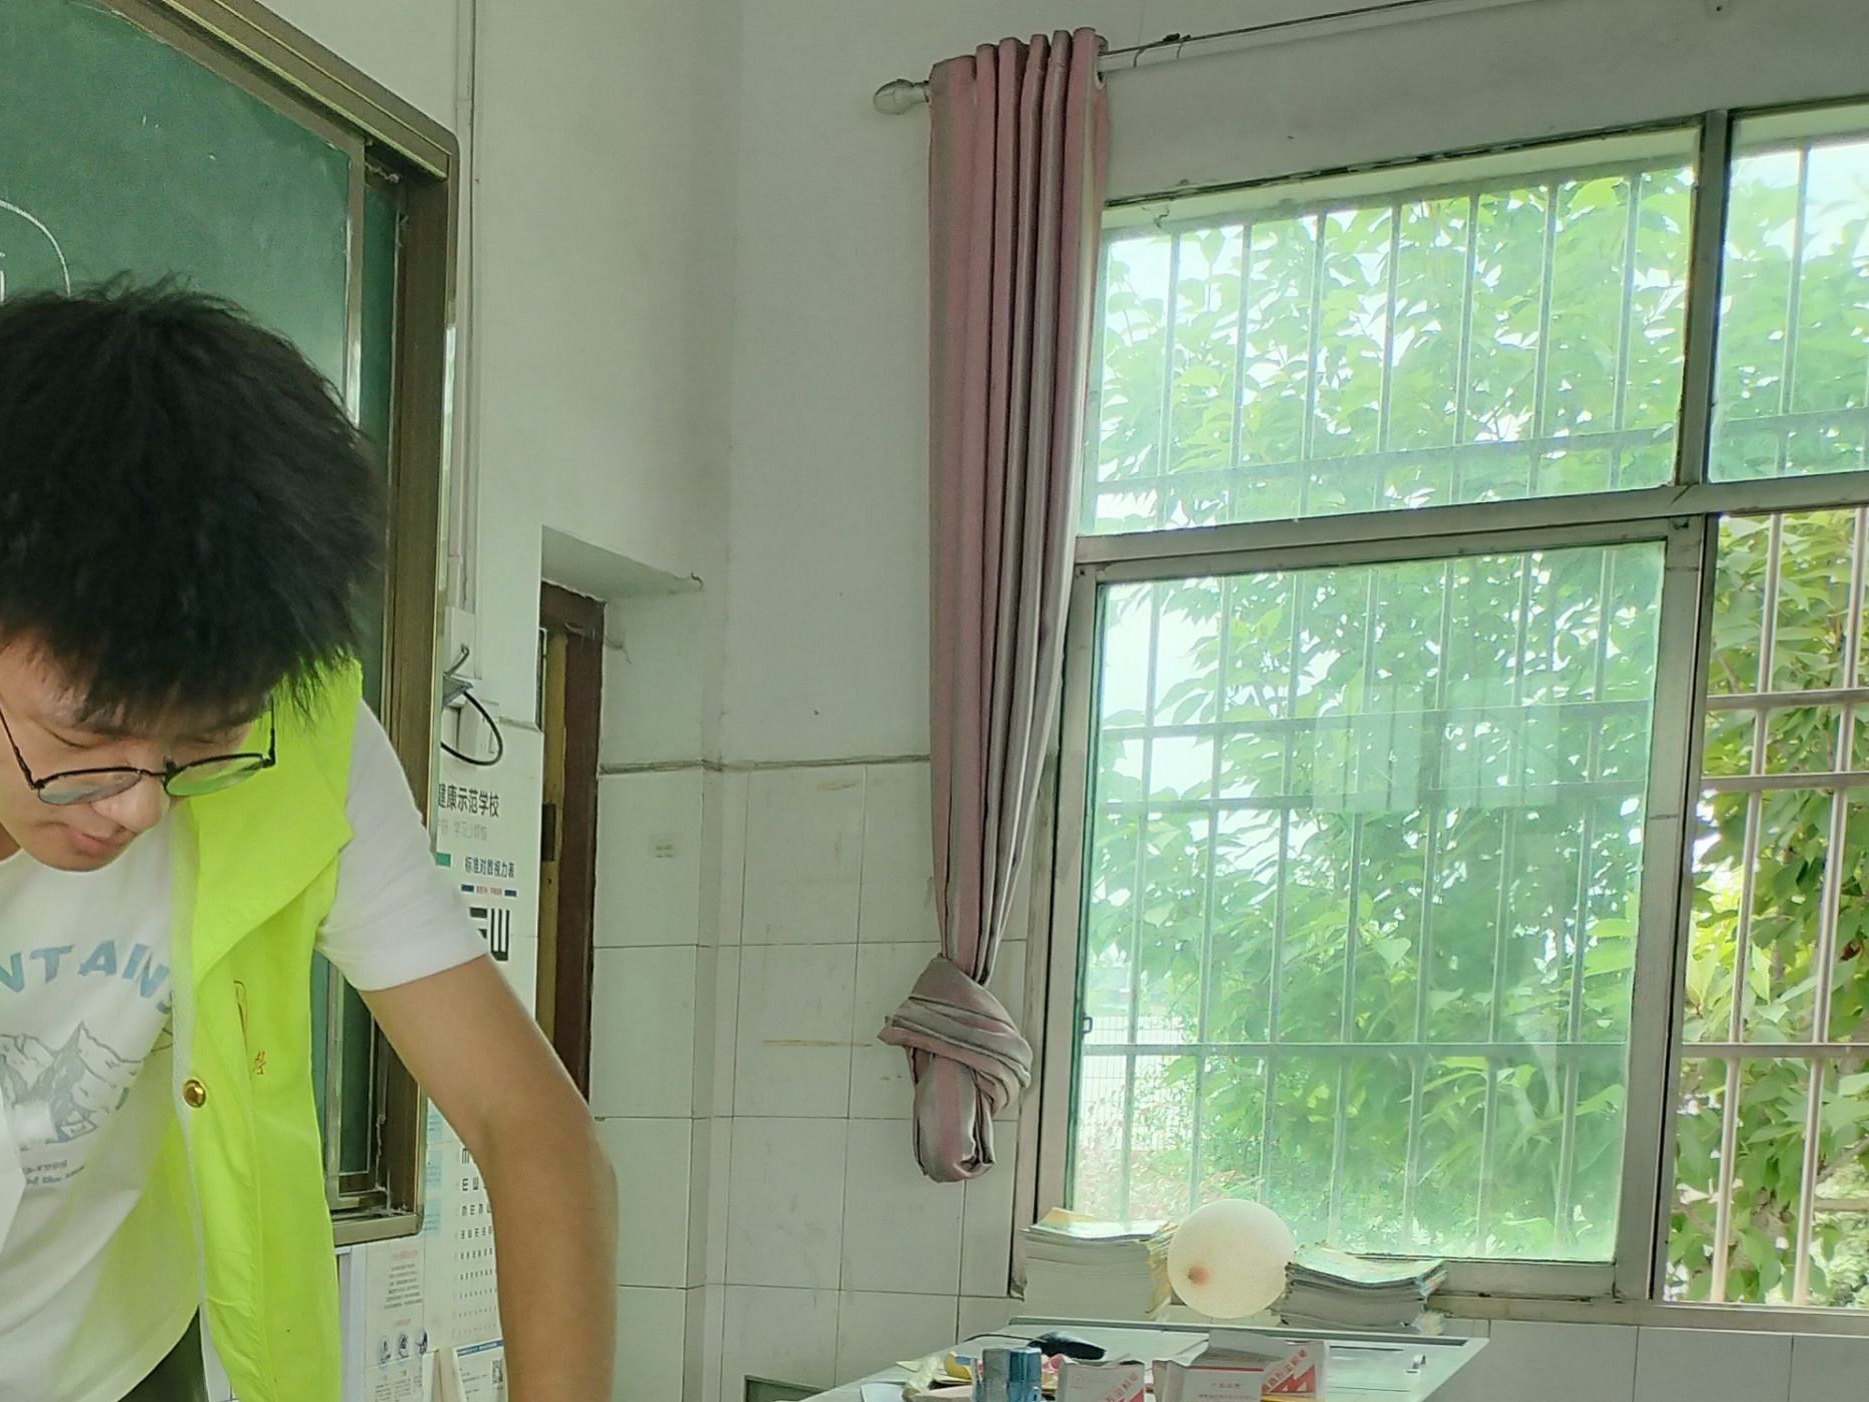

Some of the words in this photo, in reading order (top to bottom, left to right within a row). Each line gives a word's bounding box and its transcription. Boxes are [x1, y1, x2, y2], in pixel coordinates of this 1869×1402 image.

[464, 856, 515, 879] 标准对数视力表
